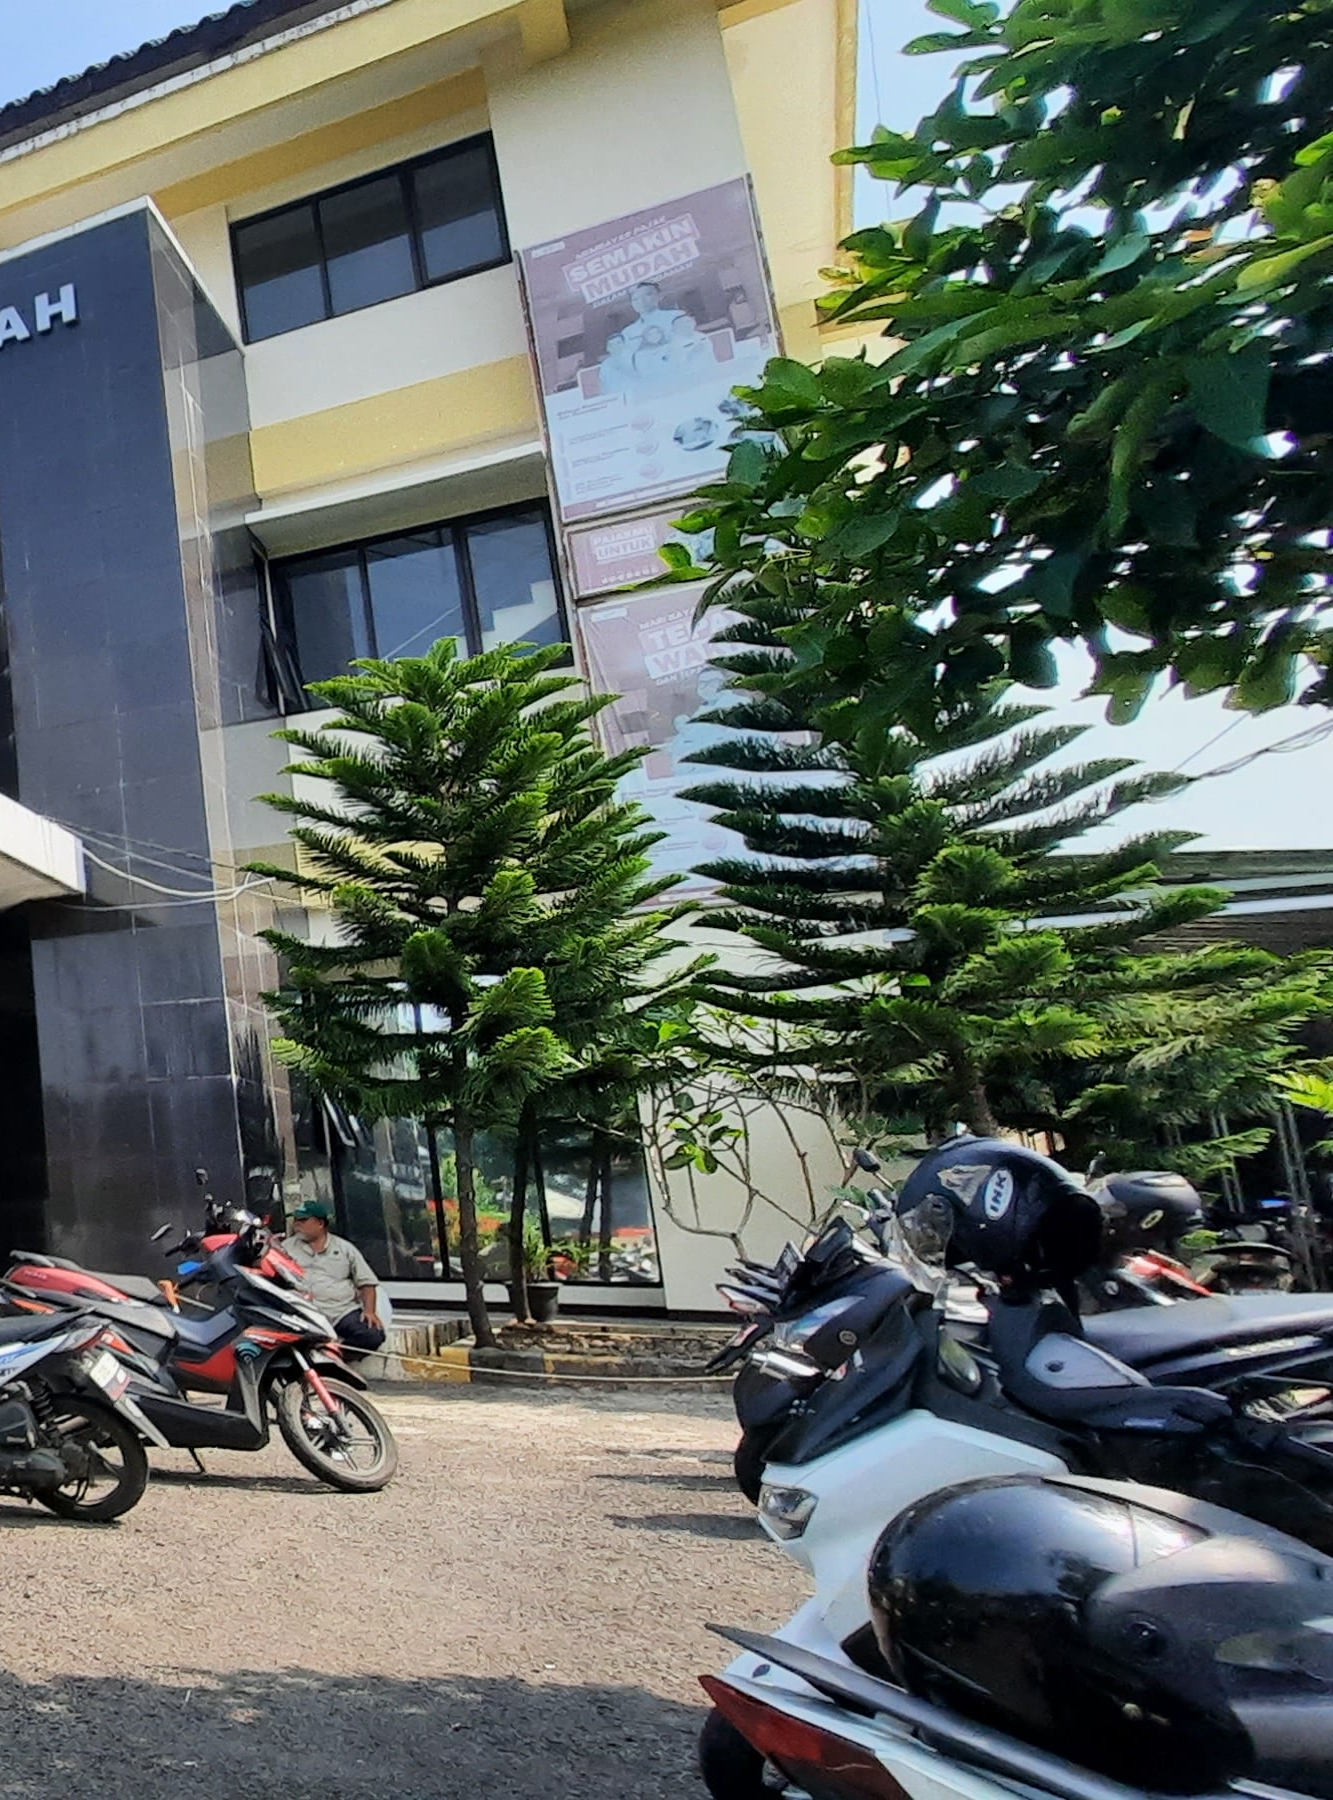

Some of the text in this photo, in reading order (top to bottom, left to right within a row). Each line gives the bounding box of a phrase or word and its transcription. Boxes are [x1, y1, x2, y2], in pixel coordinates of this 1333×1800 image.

[569, 220, 691, 282] SEMAKIN
[587, 241, 696, 299] MUDAH
[598, 538, 651, 558] UNTUK
